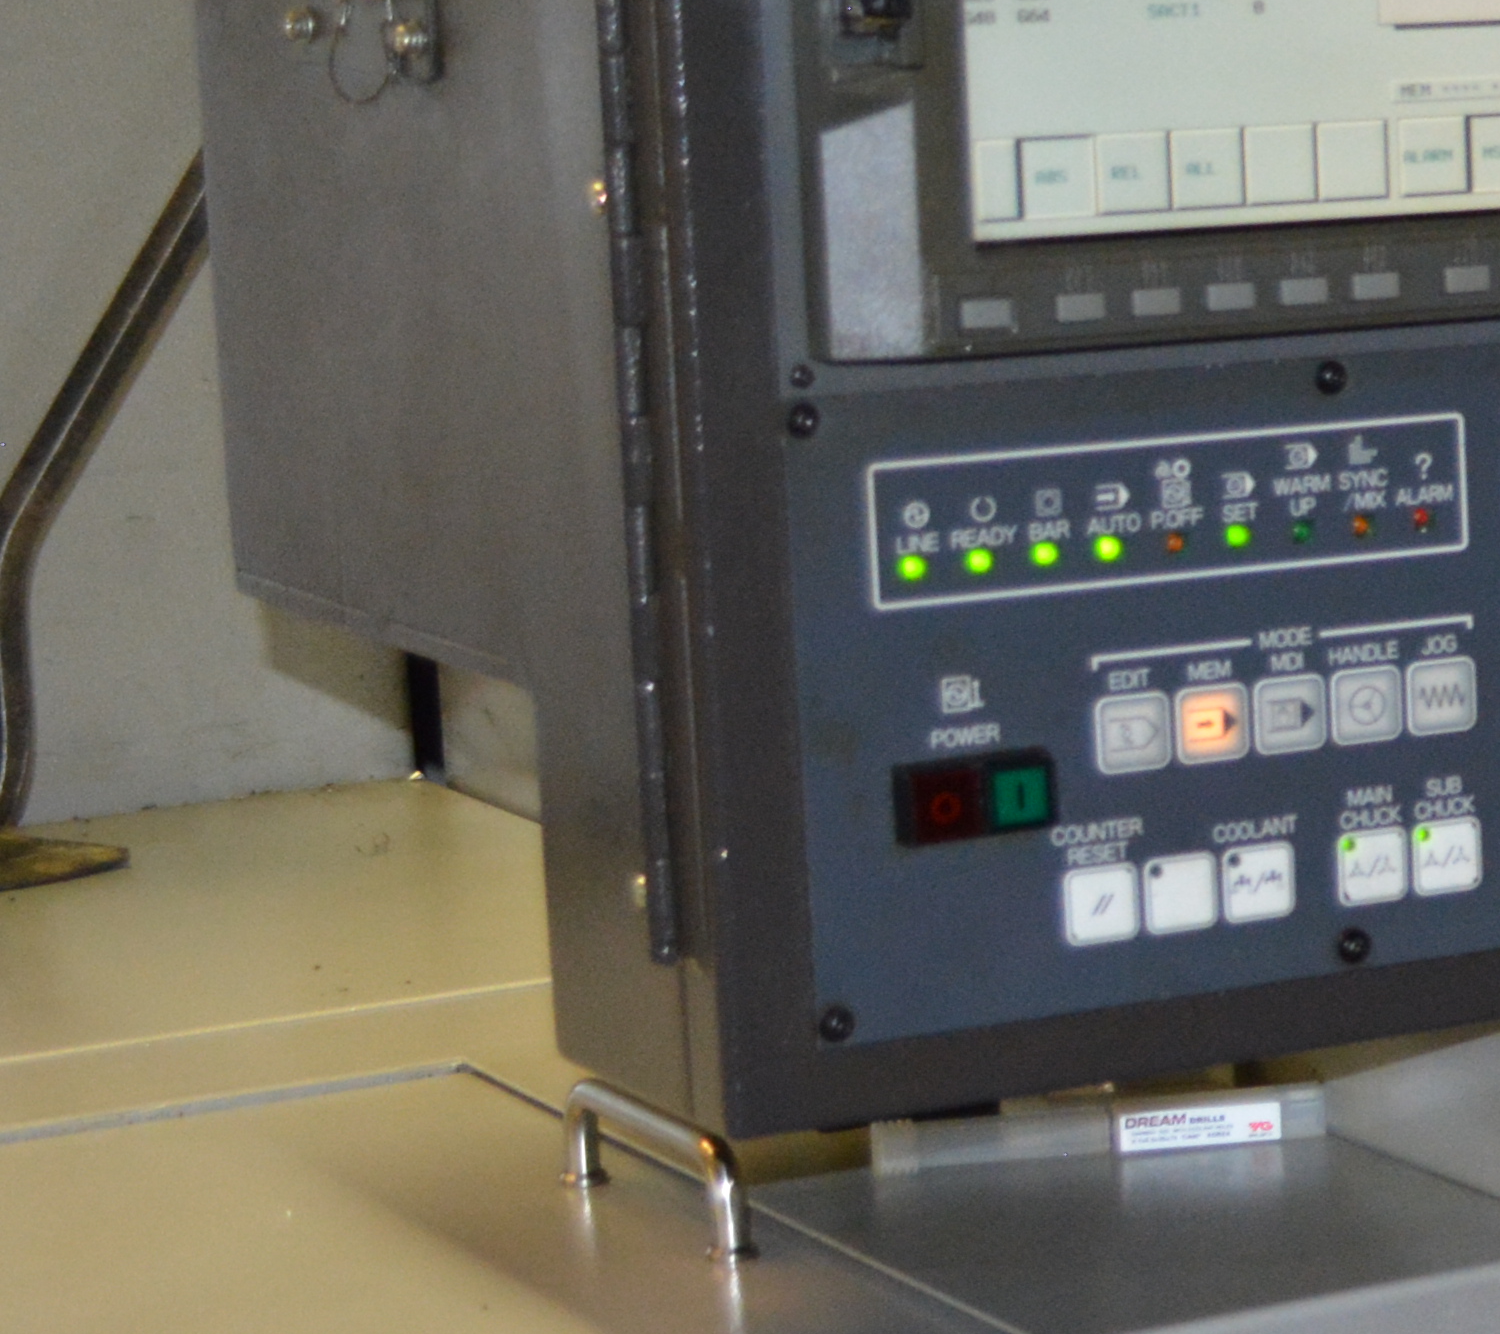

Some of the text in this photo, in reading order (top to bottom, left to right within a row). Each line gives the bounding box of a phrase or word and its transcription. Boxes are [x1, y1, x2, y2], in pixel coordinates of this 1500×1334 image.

[1273, 473, 1331, 496] WARM
[1338, 468, 1388, 491] SYNC
[1289, 496, 1316, 517] UP
[1395, 484, 1453, 506] ALARM
[1087, 512, 1142, 535] AUTO
[1222, 502, 1258, 522] SET
[951, 524, 1018, 550] READY
[1028, 519, 1070, 541] BAR
[896, 531, 939, 554] LINE
[1258, 626, 1313, 651] MODE
[1421, 633, 1457, 656] JOG
[1271, 651, 1305, 672] MDI
[1328, 641, 1398, 667] HANDLE
[1108, 668, 1150, 691] EDIT
[1188, 659, 1232, 681] MEM
[930, 723, 999, 749] POWER
[1346, 785, 1392, 808] MAIN
[1426, 776, 1461, 798] SUB
[1339, 803, 1401, 830] CHUCK
[1414, 794, 1474, 820] CHUCK
[1051, 817, 1143, 847] COUNTER
[1213, 815, 1297, 842] COOLANT
[1067, 841, 1128, 866] RESET
[1124, 1113, 1187, 1130] DREAM
